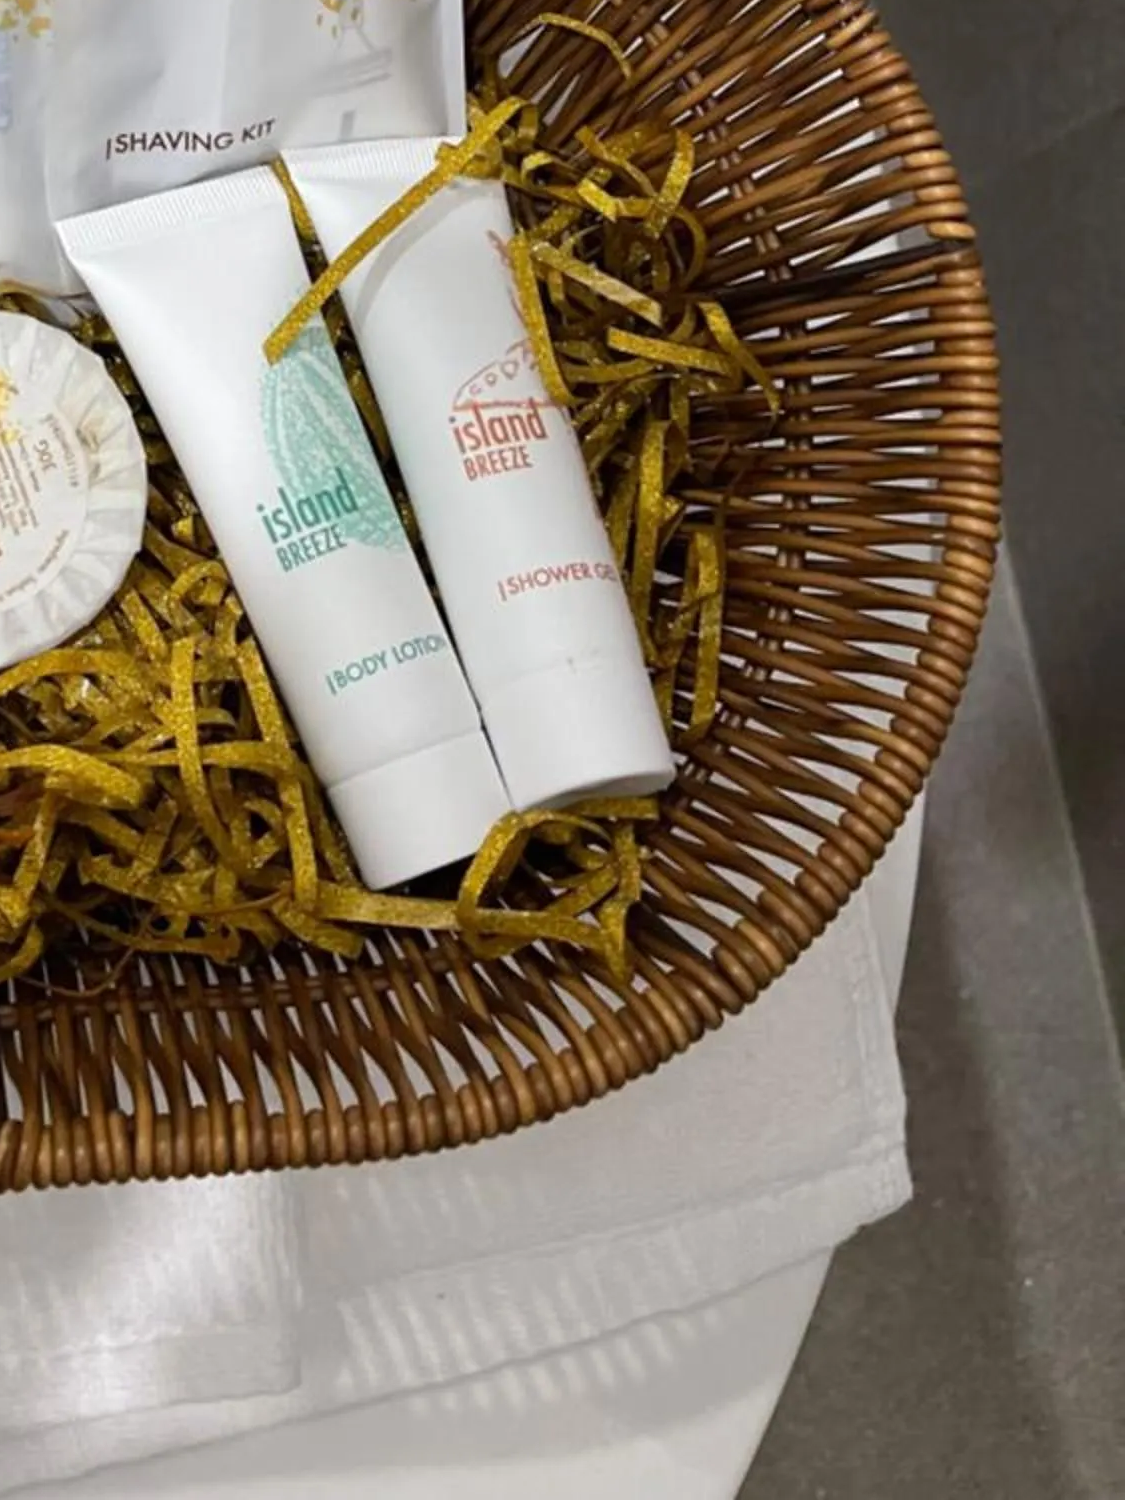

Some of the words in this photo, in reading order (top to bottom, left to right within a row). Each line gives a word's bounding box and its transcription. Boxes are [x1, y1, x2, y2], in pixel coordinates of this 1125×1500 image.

[242, 117, 276, 143] KIT
[449, 396, 549, 454] island
[464, 445, 533, 481] BREEZE
[256, 466, 360, 544] island
[276, 523, 348, 573] BREEZE
